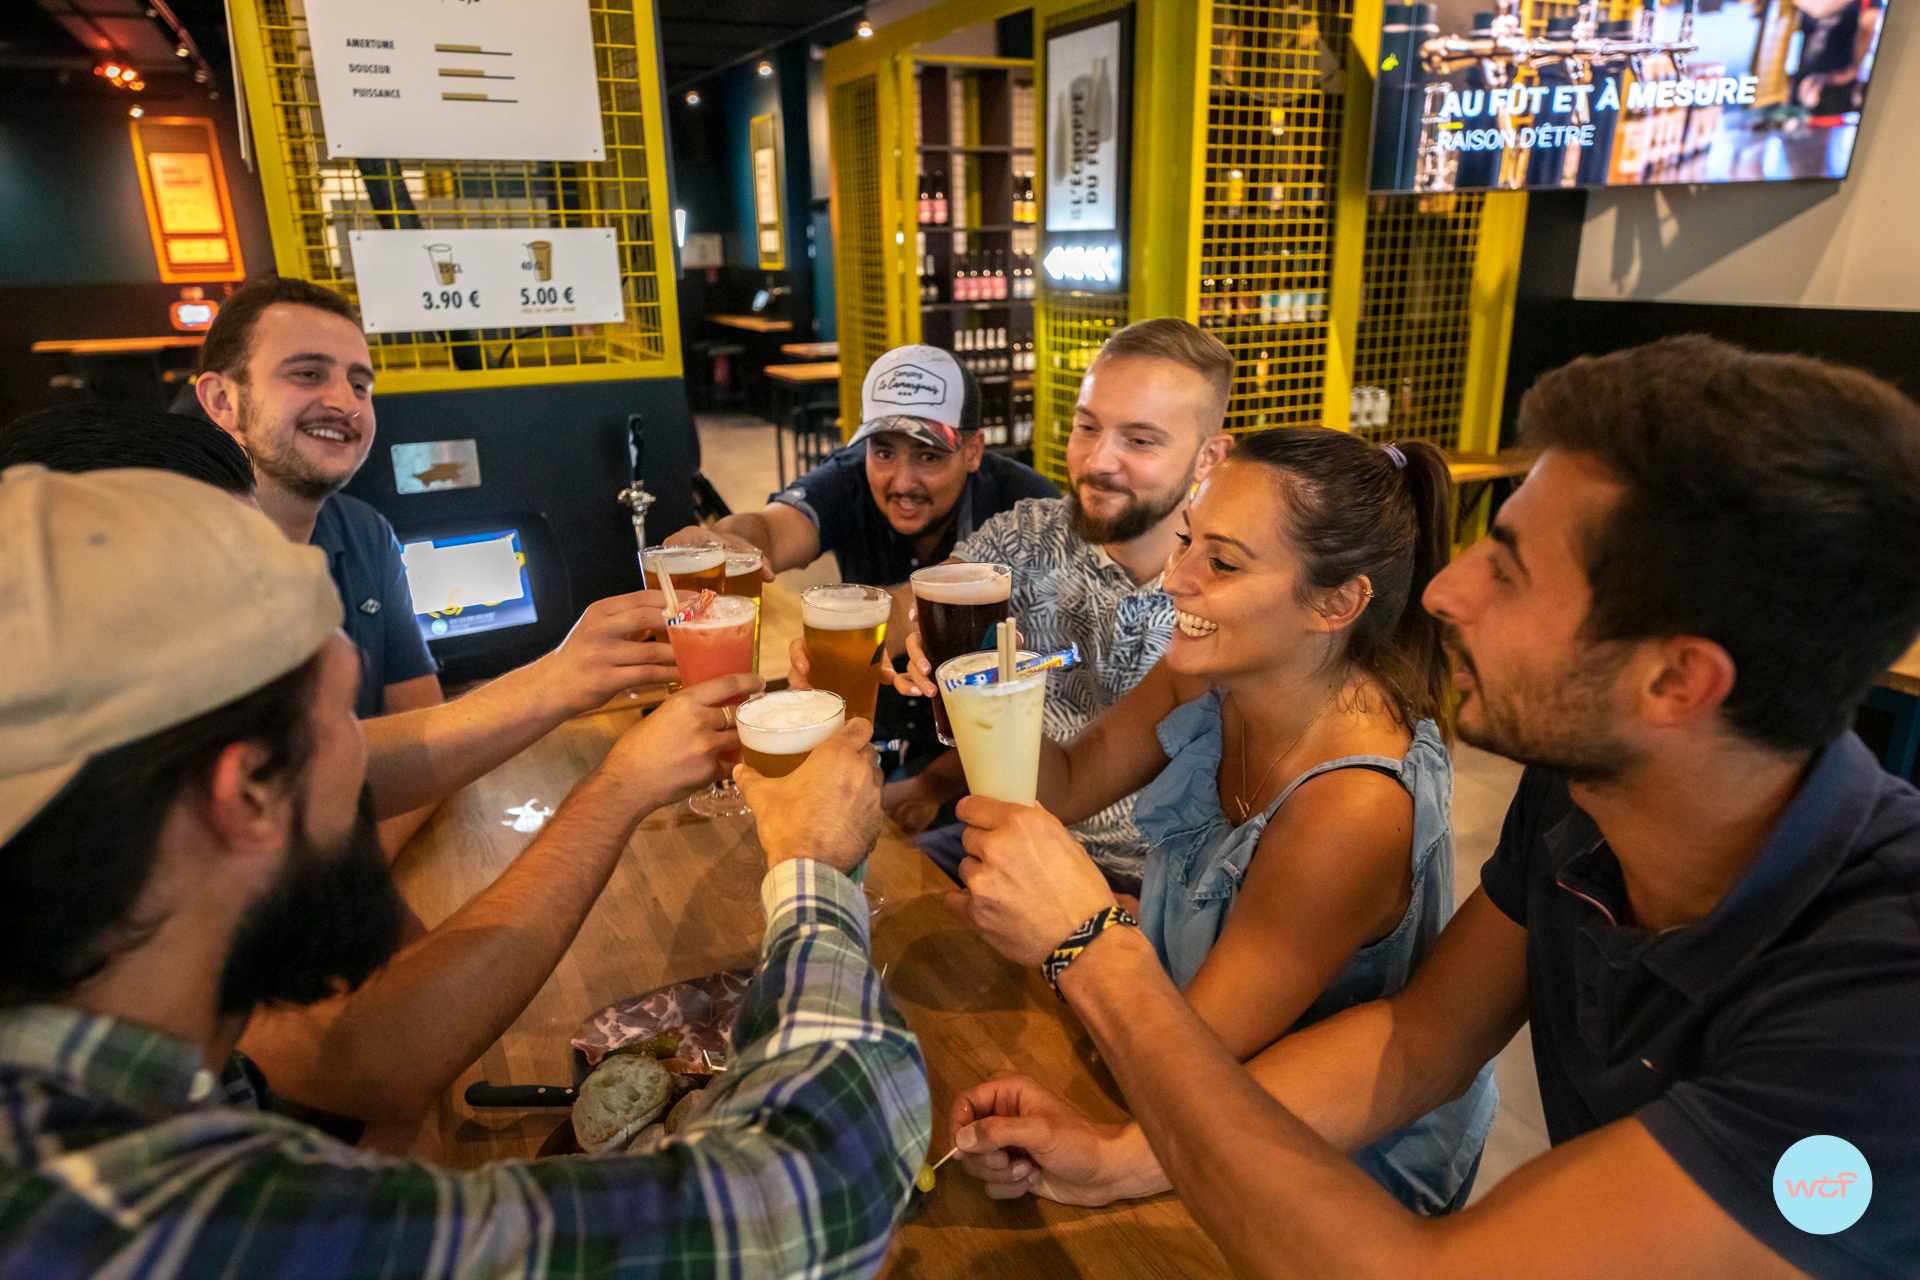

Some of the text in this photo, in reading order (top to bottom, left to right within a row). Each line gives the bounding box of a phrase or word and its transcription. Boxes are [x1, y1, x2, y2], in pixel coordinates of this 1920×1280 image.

[346, 38, 395, 50] AMERTUME
[349, 63, 391, 74] DOUCEUR
[352, 88, 401, 99] PUISSANCE
[1438, 76, 1760, 118] AU FÛT ET À MESURE
[1437, 122, 1596, 151] RAISON D'ÊTRE
[422, 289, 481, 310] 3.90 €
[520, 286, 575, 306] 5.00 €
